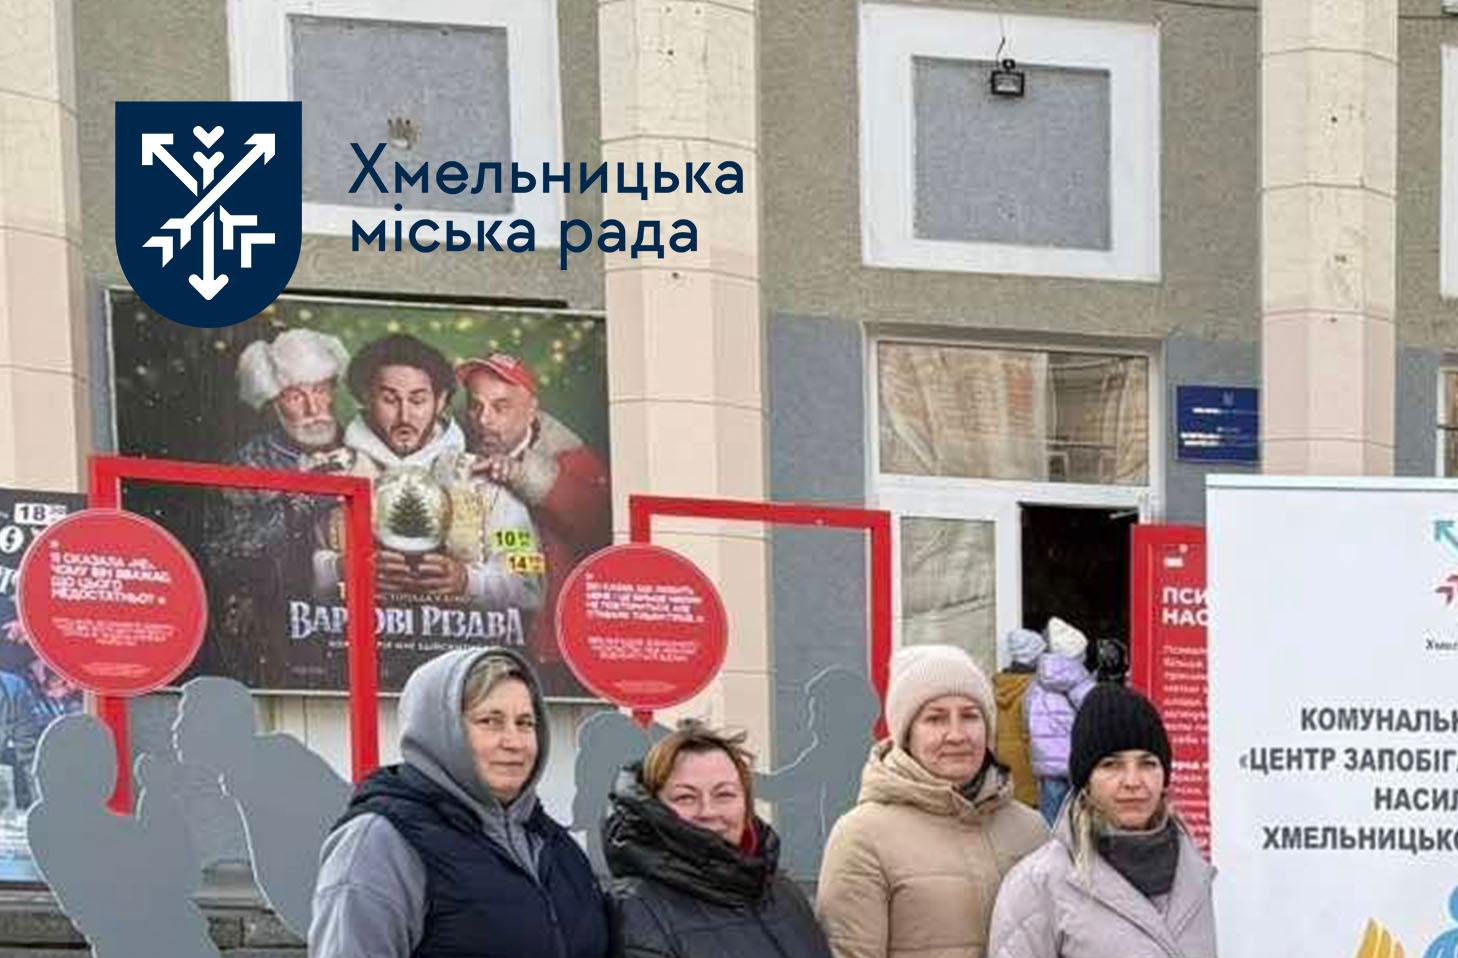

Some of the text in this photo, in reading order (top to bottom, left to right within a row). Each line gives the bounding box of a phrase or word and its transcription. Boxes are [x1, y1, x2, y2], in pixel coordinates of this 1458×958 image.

[20, 505, 46, 521] 18
[420, 604, 525, 646] РІЗДВА
[1239, 747, 1337, 775] «ЦЕНТР
